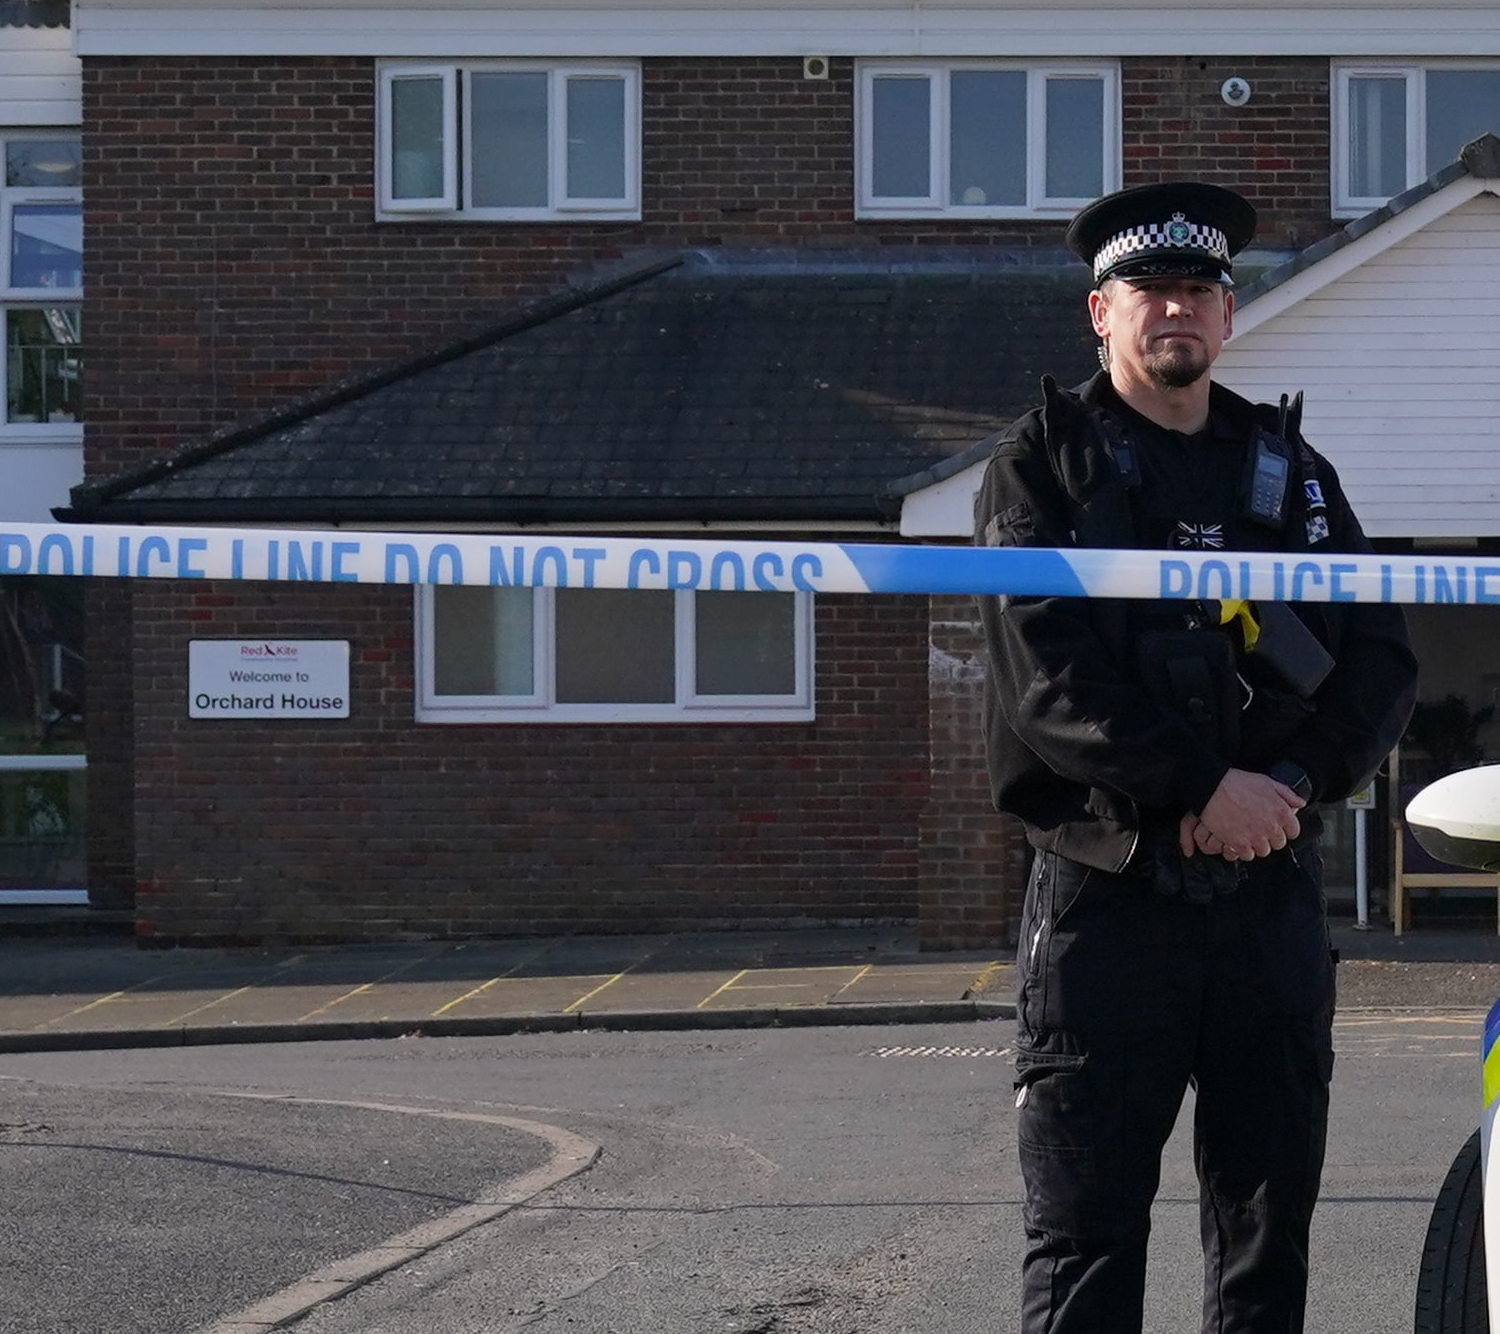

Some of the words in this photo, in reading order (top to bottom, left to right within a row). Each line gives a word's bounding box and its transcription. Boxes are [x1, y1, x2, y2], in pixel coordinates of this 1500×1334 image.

[231, 539, 361, 582] LINE
[385, 543, 464, 585] DO
[489, 546, 607, 588] NOT
[627, 548, 824, 593] CROSS
[1159, 559, 1358, 602] POLICE
[240, 646, 262, 655] Red
[277, 646, 297, 655] Kite
[229, 671, 291, 682] Welcome
[296, 671, 309, 682] to
[195, 693, 274, 709] Orchard
[281, 693, 343, 709] House
